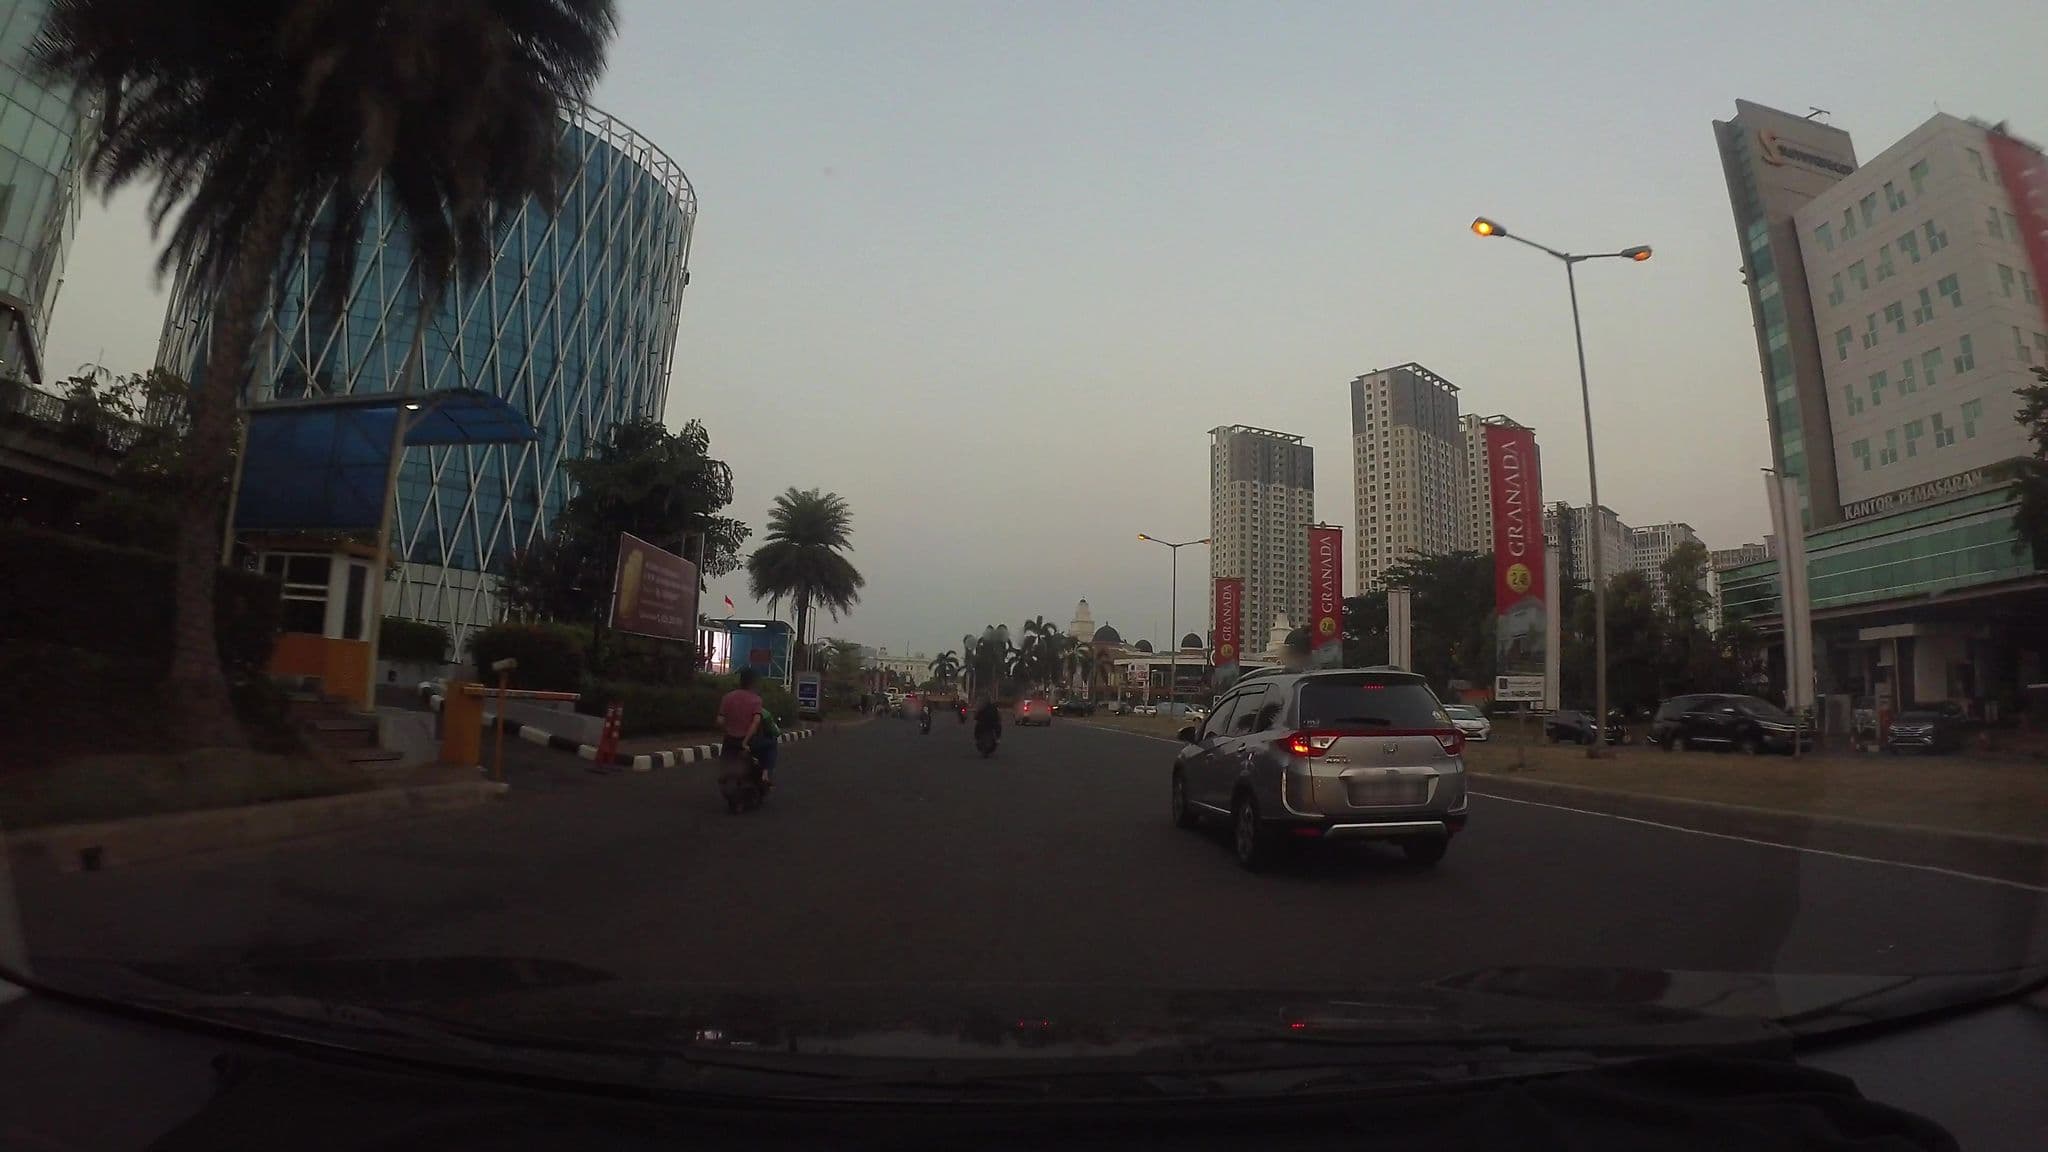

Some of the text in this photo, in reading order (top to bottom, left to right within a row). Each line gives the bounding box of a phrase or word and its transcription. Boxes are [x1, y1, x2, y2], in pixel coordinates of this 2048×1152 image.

[1501, 440, 1526, 557] GRANADA
[1844, 471, 1983, 520] KANTOR PEMASARAN
[1319, 536, 1334, 613] GRANADA
[1222, 585, 1233, 641] GRANADA
